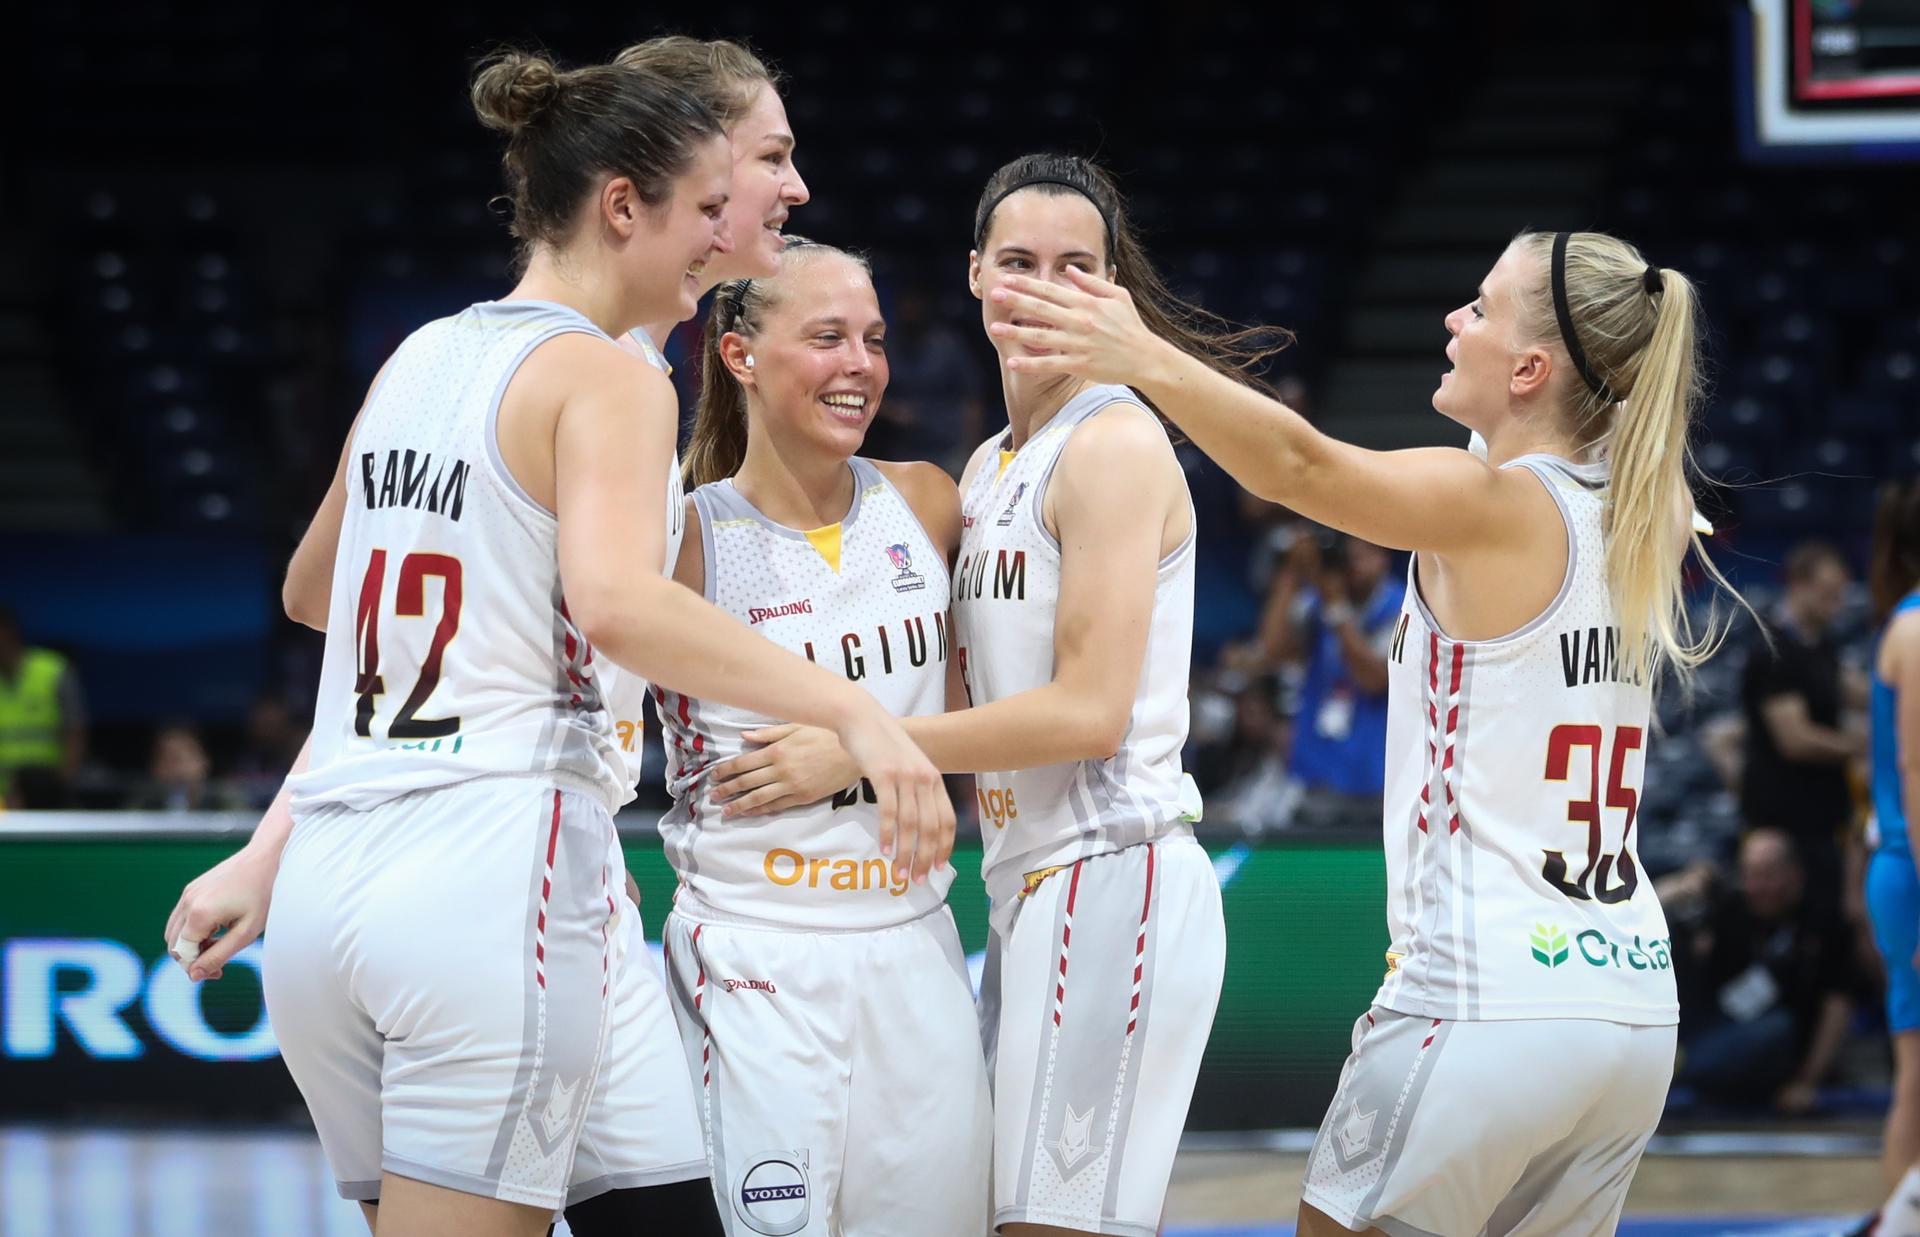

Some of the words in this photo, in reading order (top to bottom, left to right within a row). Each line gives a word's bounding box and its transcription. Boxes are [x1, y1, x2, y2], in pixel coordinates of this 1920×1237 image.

[362, 448, 471, 522] RAMAN
[749, 599, 813, 624] SPALDING
[354, 548, 462, 738] 42
[1560, 626, 1659, 687] VAN
[1541, 724, 1643, 904] 35
[764, 847, 910, 897] Orang
[1576, 929, 1671, 970] Crela
[745, 1187, 804, 1200] VOLVO
